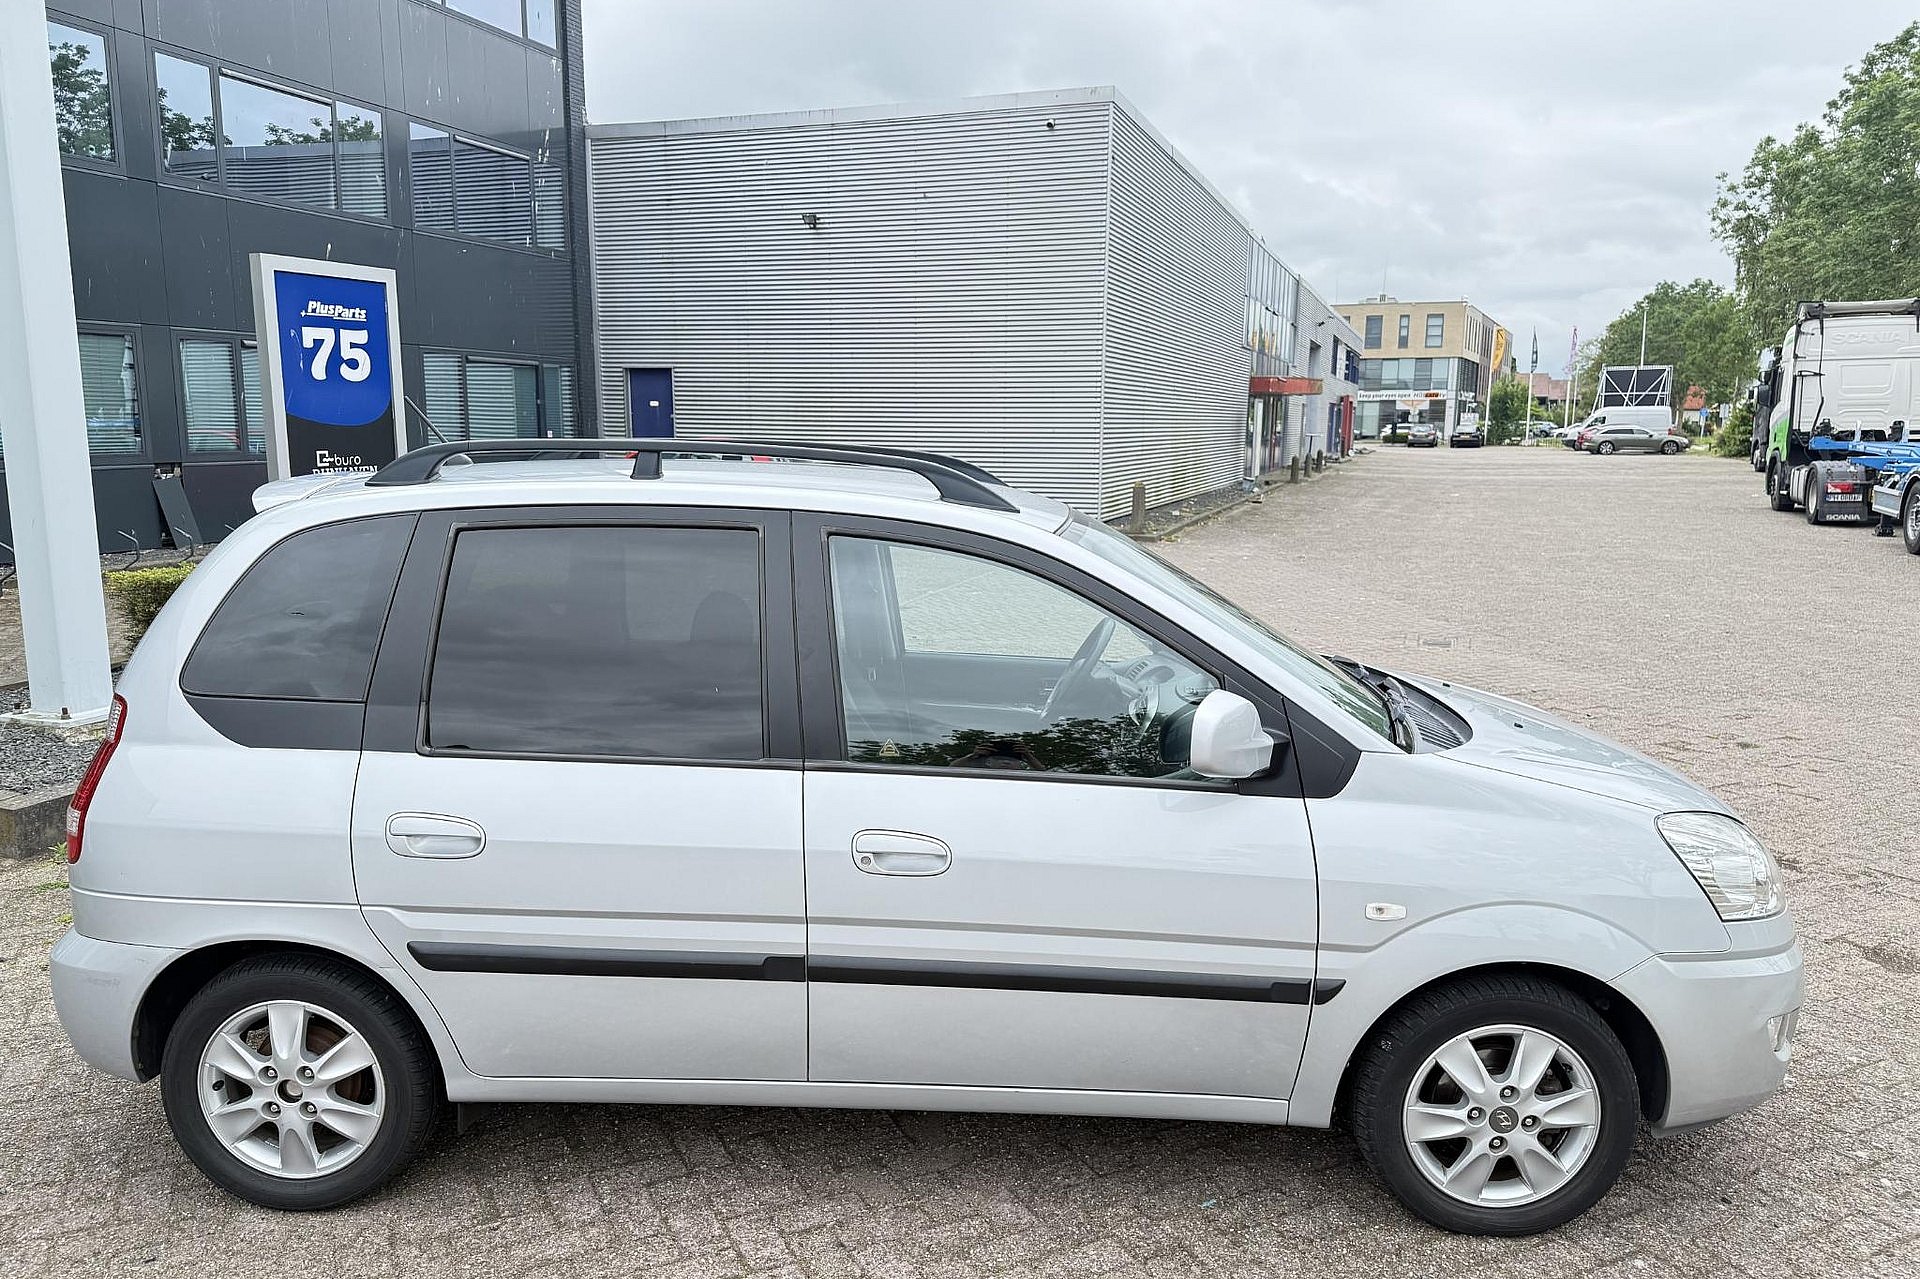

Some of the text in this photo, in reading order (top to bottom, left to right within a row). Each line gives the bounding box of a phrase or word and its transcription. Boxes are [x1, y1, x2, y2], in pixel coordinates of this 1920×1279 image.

[1831, 331, 1902, 345] SCANIA
[301, 326, 372, 382] 75
[1826, 513, 1860, 521] SCANIA
